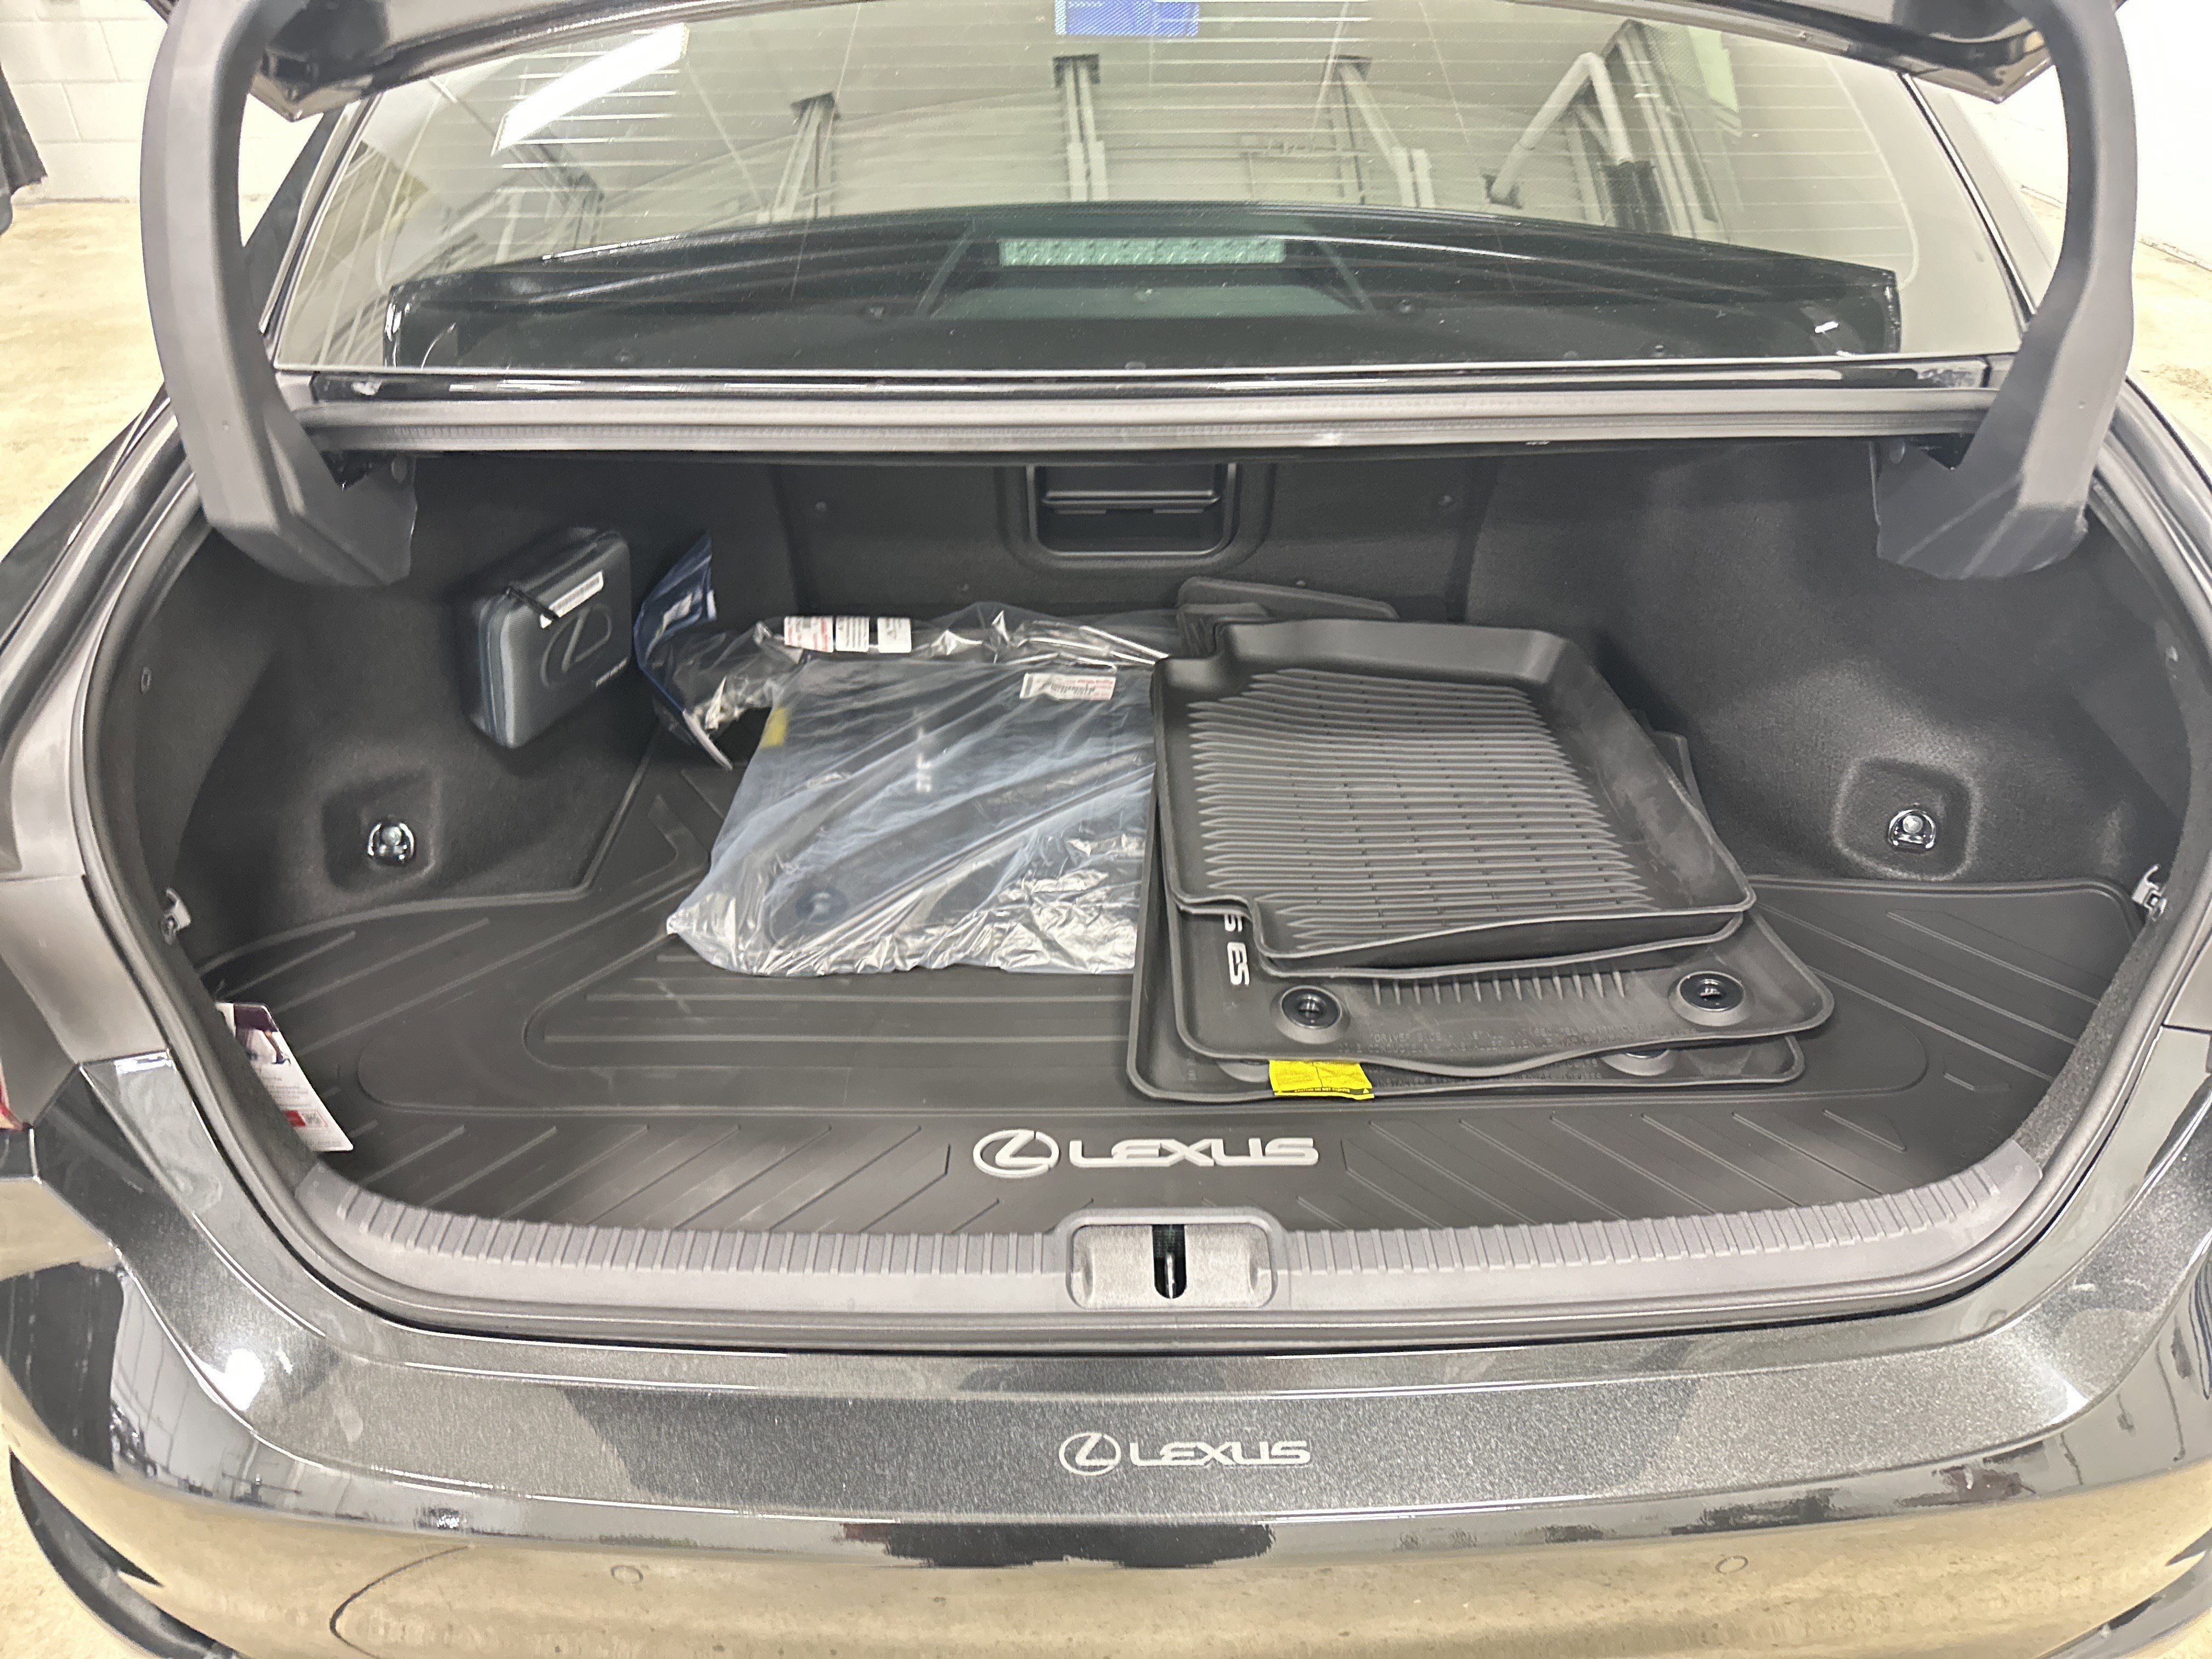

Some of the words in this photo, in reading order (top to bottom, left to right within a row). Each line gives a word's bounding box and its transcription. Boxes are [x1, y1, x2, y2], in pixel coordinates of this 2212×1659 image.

[1227, 942, 1250, 985] ES
[1069, 1137, 1319, 1167] LEXUS
[1130, 1440, 1311, 1465] LEXUS
